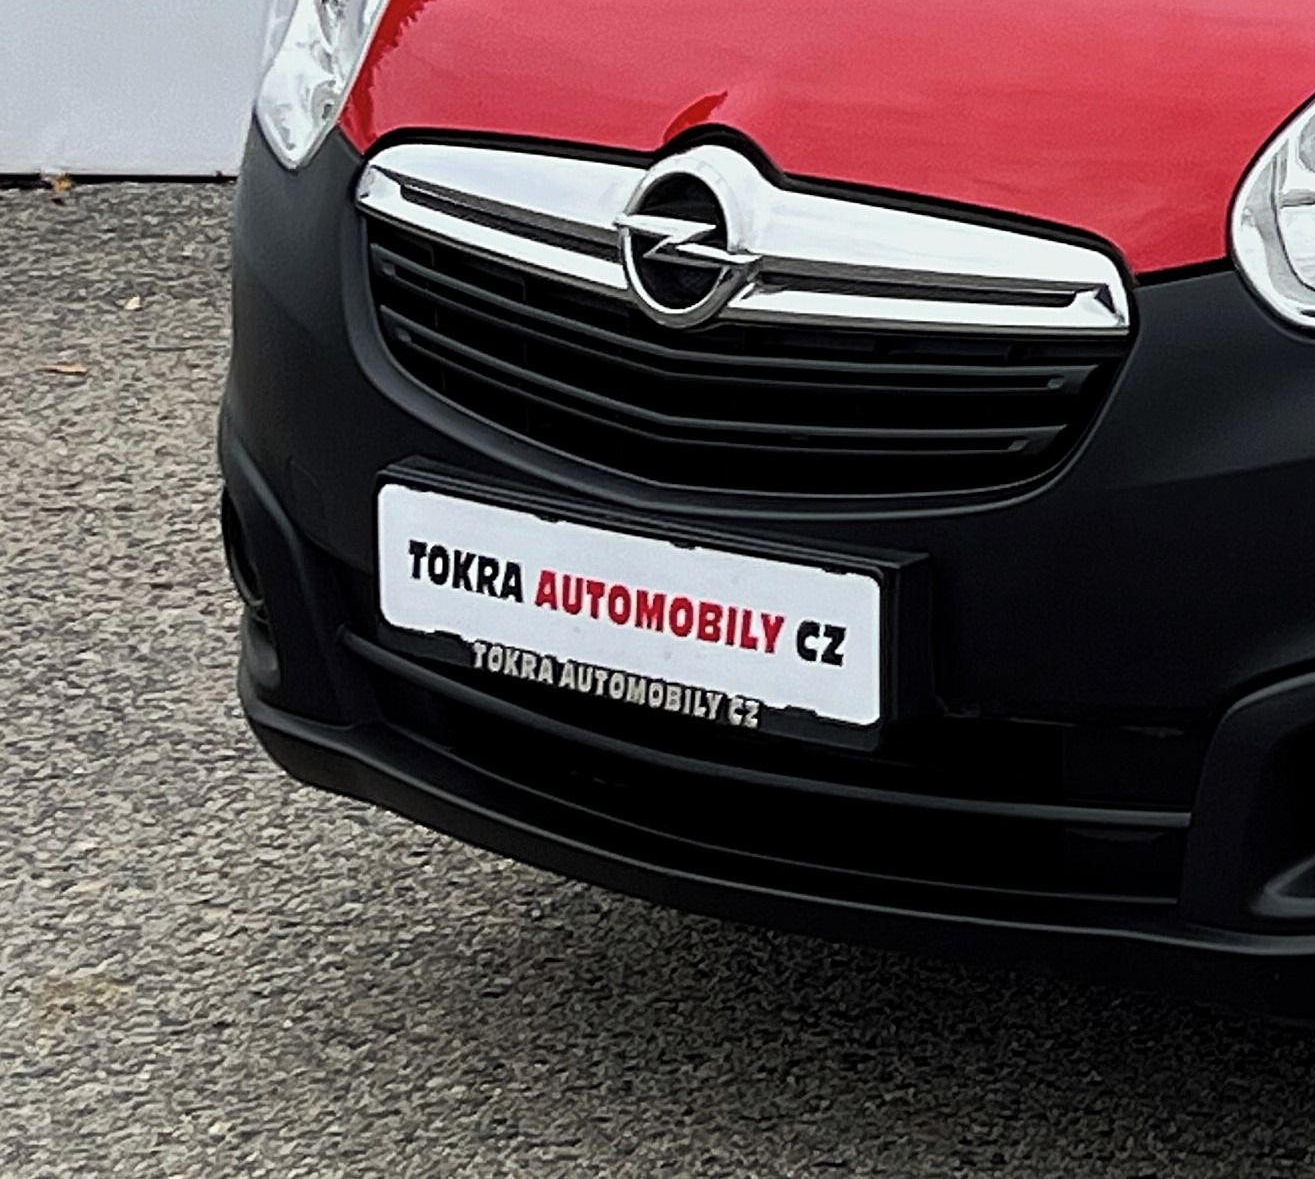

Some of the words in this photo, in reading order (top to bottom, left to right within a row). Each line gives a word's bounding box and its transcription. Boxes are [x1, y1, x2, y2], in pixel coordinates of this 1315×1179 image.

[408, 539, 524, 604] TOKRA
[534, 570, 787, 654] AUTOMOBILY
[795, 621, 847, 667] CZ
[473, 642, 554, 686] TOKRA
[557, 660, 724, 722] AUTOMOBILY
[727, 697, 760, 728] CZ
